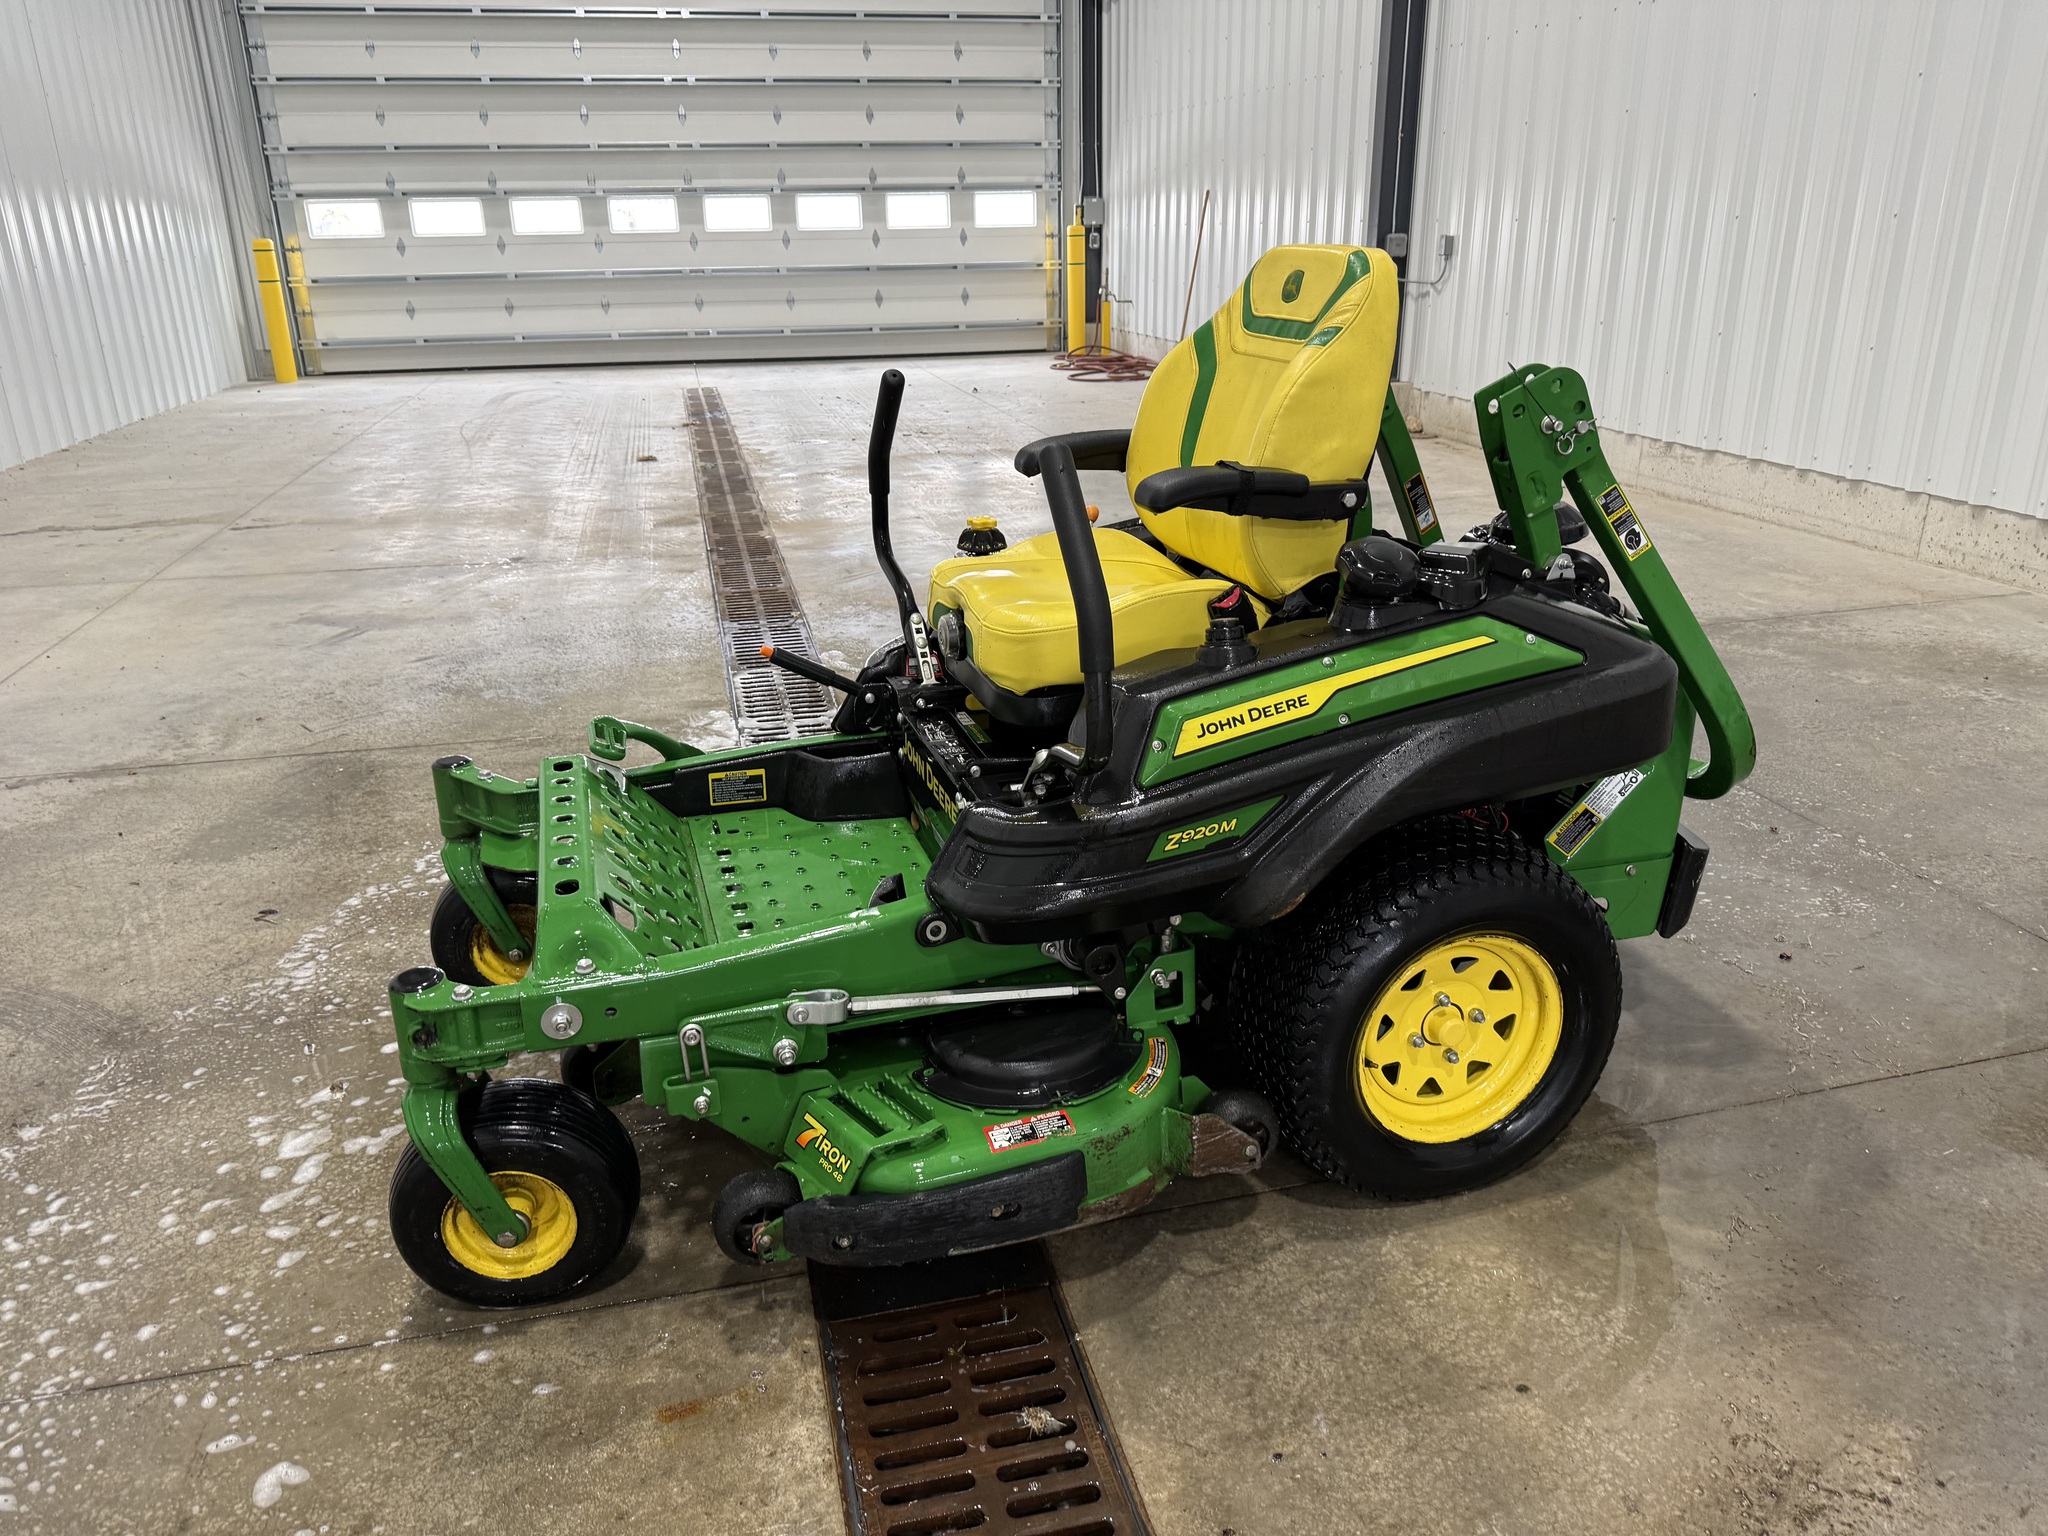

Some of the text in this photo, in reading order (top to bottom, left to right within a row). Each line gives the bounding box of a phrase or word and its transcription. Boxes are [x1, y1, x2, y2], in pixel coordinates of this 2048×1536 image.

[1197, 694, 1309, 739] JOHN DEERE
[902, 731, 925, 781] JOHN
[1164, 818, 1237, 851] Z920M
[1000, 1119, 1023, 1129] DANGER
[1036, 1110, 1060, 1120] PELIGRO
[819, 1157, 843, 1183] PRO 48
